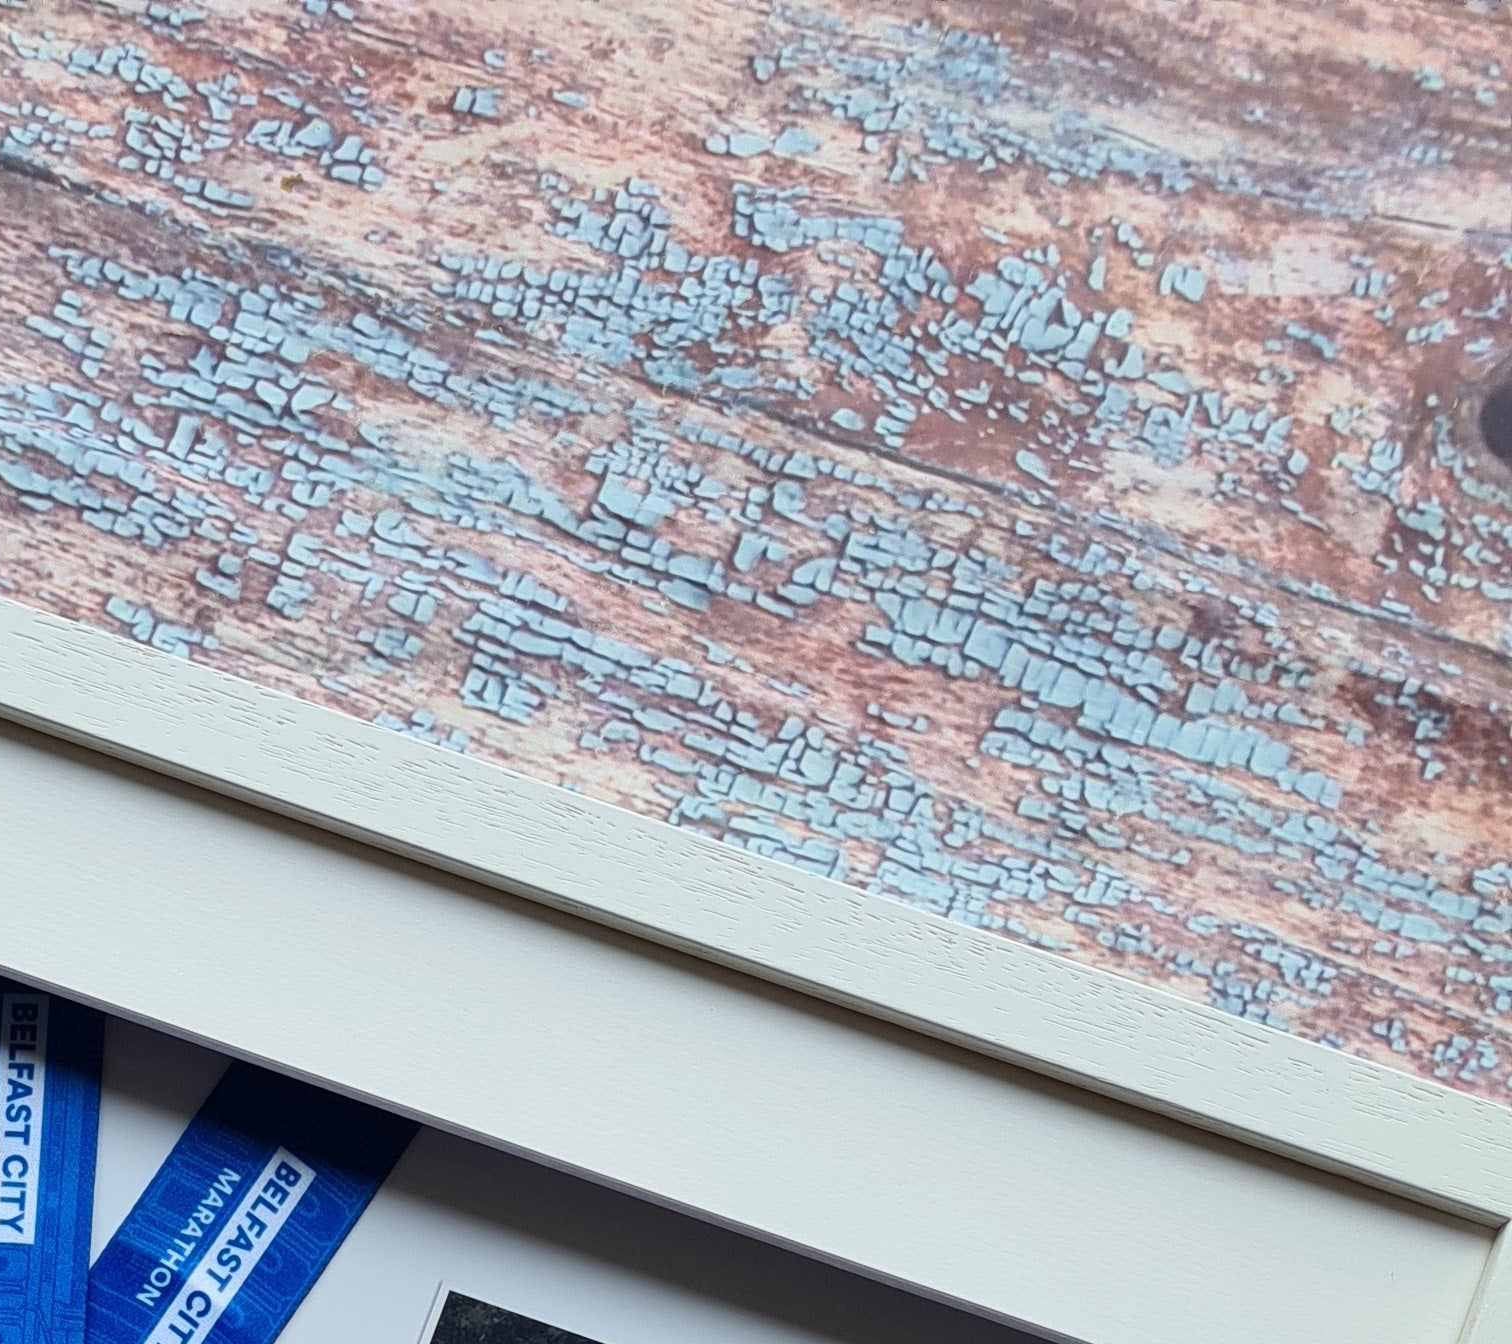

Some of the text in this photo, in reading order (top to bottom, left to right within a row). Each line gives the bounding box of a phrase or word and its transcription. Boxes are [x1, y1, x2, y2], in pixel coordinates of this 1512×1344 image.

[3, 1001, 38, 1147] BELFAST
[136, 1166, 242, 1309] MARATHON
[200, 1160, 305, 1295] BELFAST
